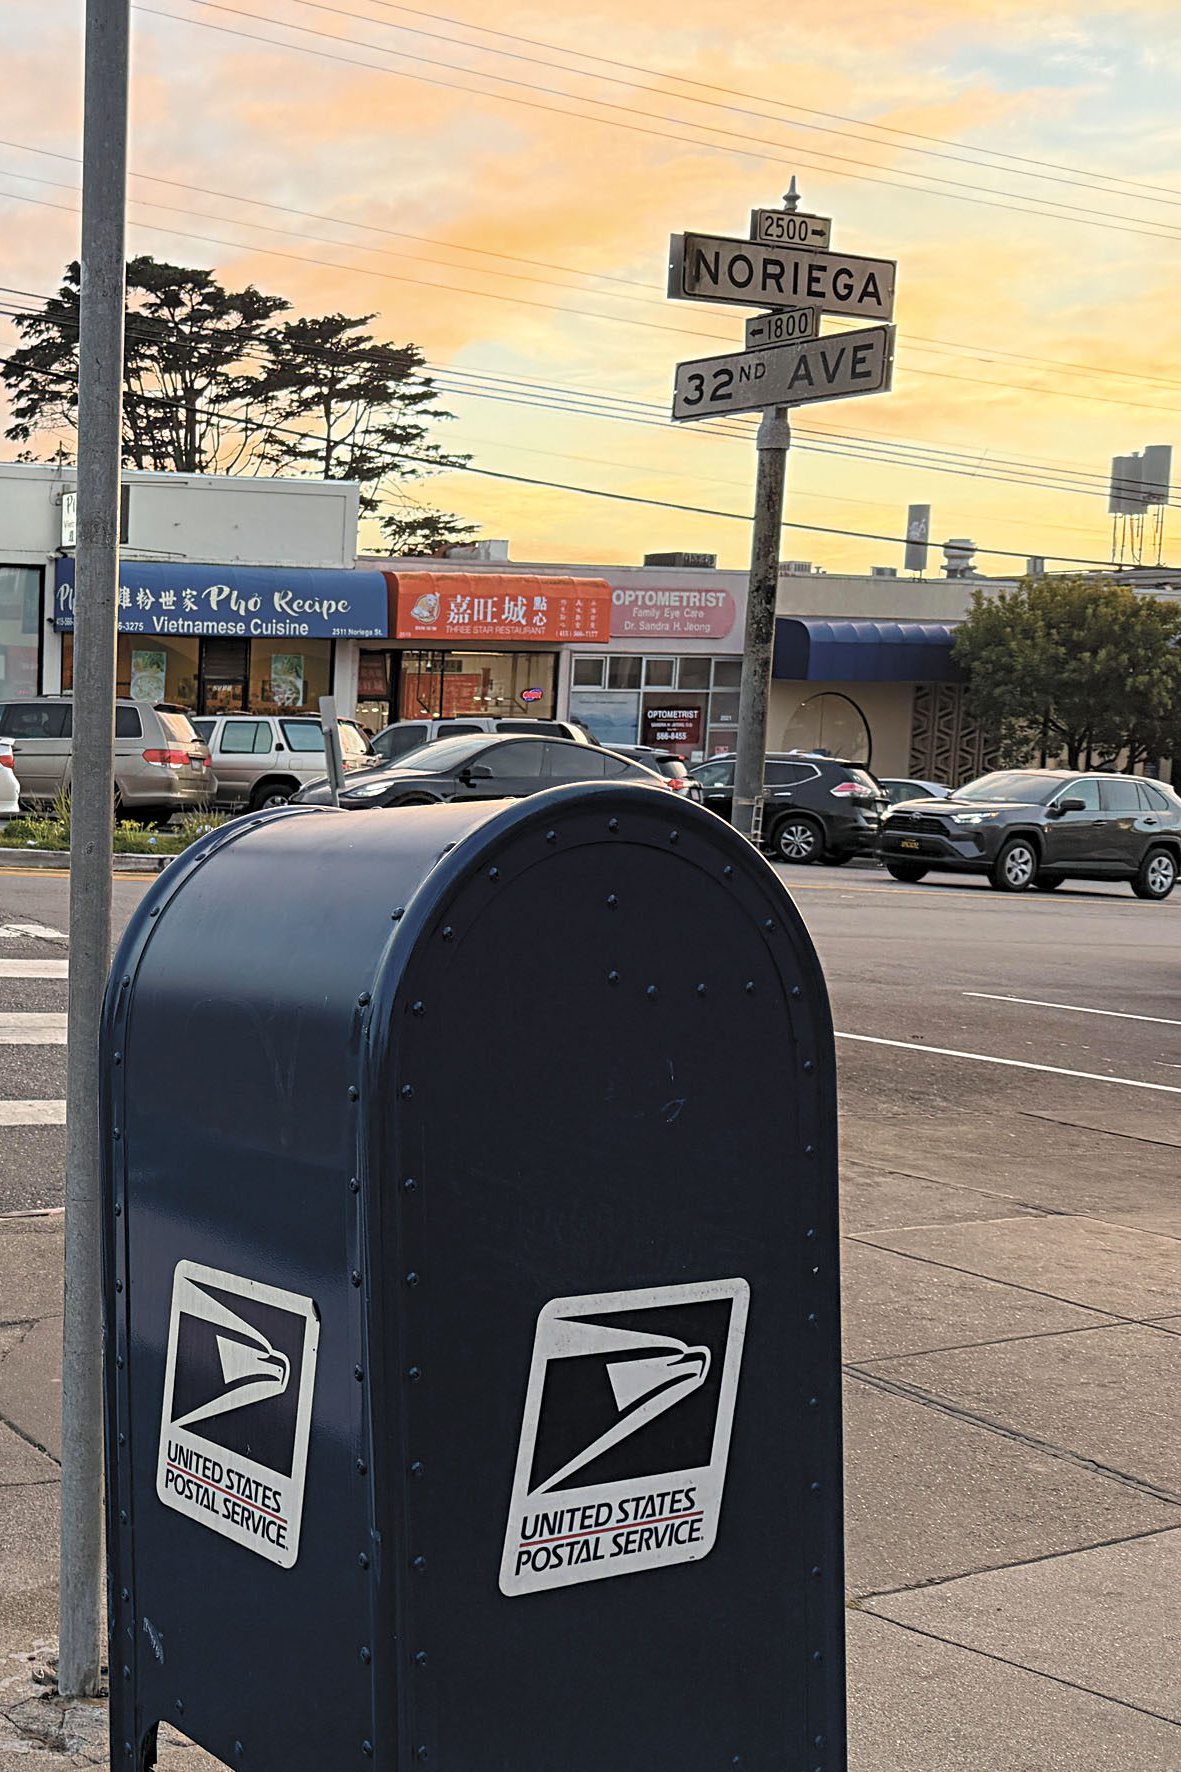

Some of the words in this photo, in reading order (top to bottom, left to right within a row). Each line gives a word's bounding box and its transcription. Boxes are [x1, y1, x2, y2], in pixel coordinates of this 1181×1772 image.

[764, 215, 808, 242] 2500
[694, 249, 883, 306] NORIEGA
[767, 312, 808, 340] 1800
[682, 361, 766, 406] 32ND
[787, 342, 874, 391] AVE
[273, 589, 352, 620] Recipe
[446, 594, 529, 625] 嘉旺城
[612, 590, 726, 607] OPTOMETRIST
[152, 616, 246, 635] Vietnamese
[250, 618, 309, 636] Cuisine
[624, 621, 636, 631] Dr.
[639, 621, 669, 631] Sandra
[684, 622, 711, 632] Jeong
[632, 607, 660, 619] Family
[664, 608, 680, 619] Eye
[684, 608, 704, 618] Care
[332, 627, 347, 636] 2511
[348, 628, 373, 637] Noriega
[446, 625, 471, 634] THREE
[472, 625, 493, 635] STAR
[494, 626, 546, 635] RESTAURANT
[647, 710, 699, 719] OPTOMETRIST
[167, 1439, 223, 1485] UNITED
[225, 1467, 282, 1514] STATES
[165, 1468, 220, 1516] POSTAL
[520, 1502, 613, 1541] UNITED
[616, 1487, 696, 1524] STATES
[514, 1538, 605, 1576] POSTAL
